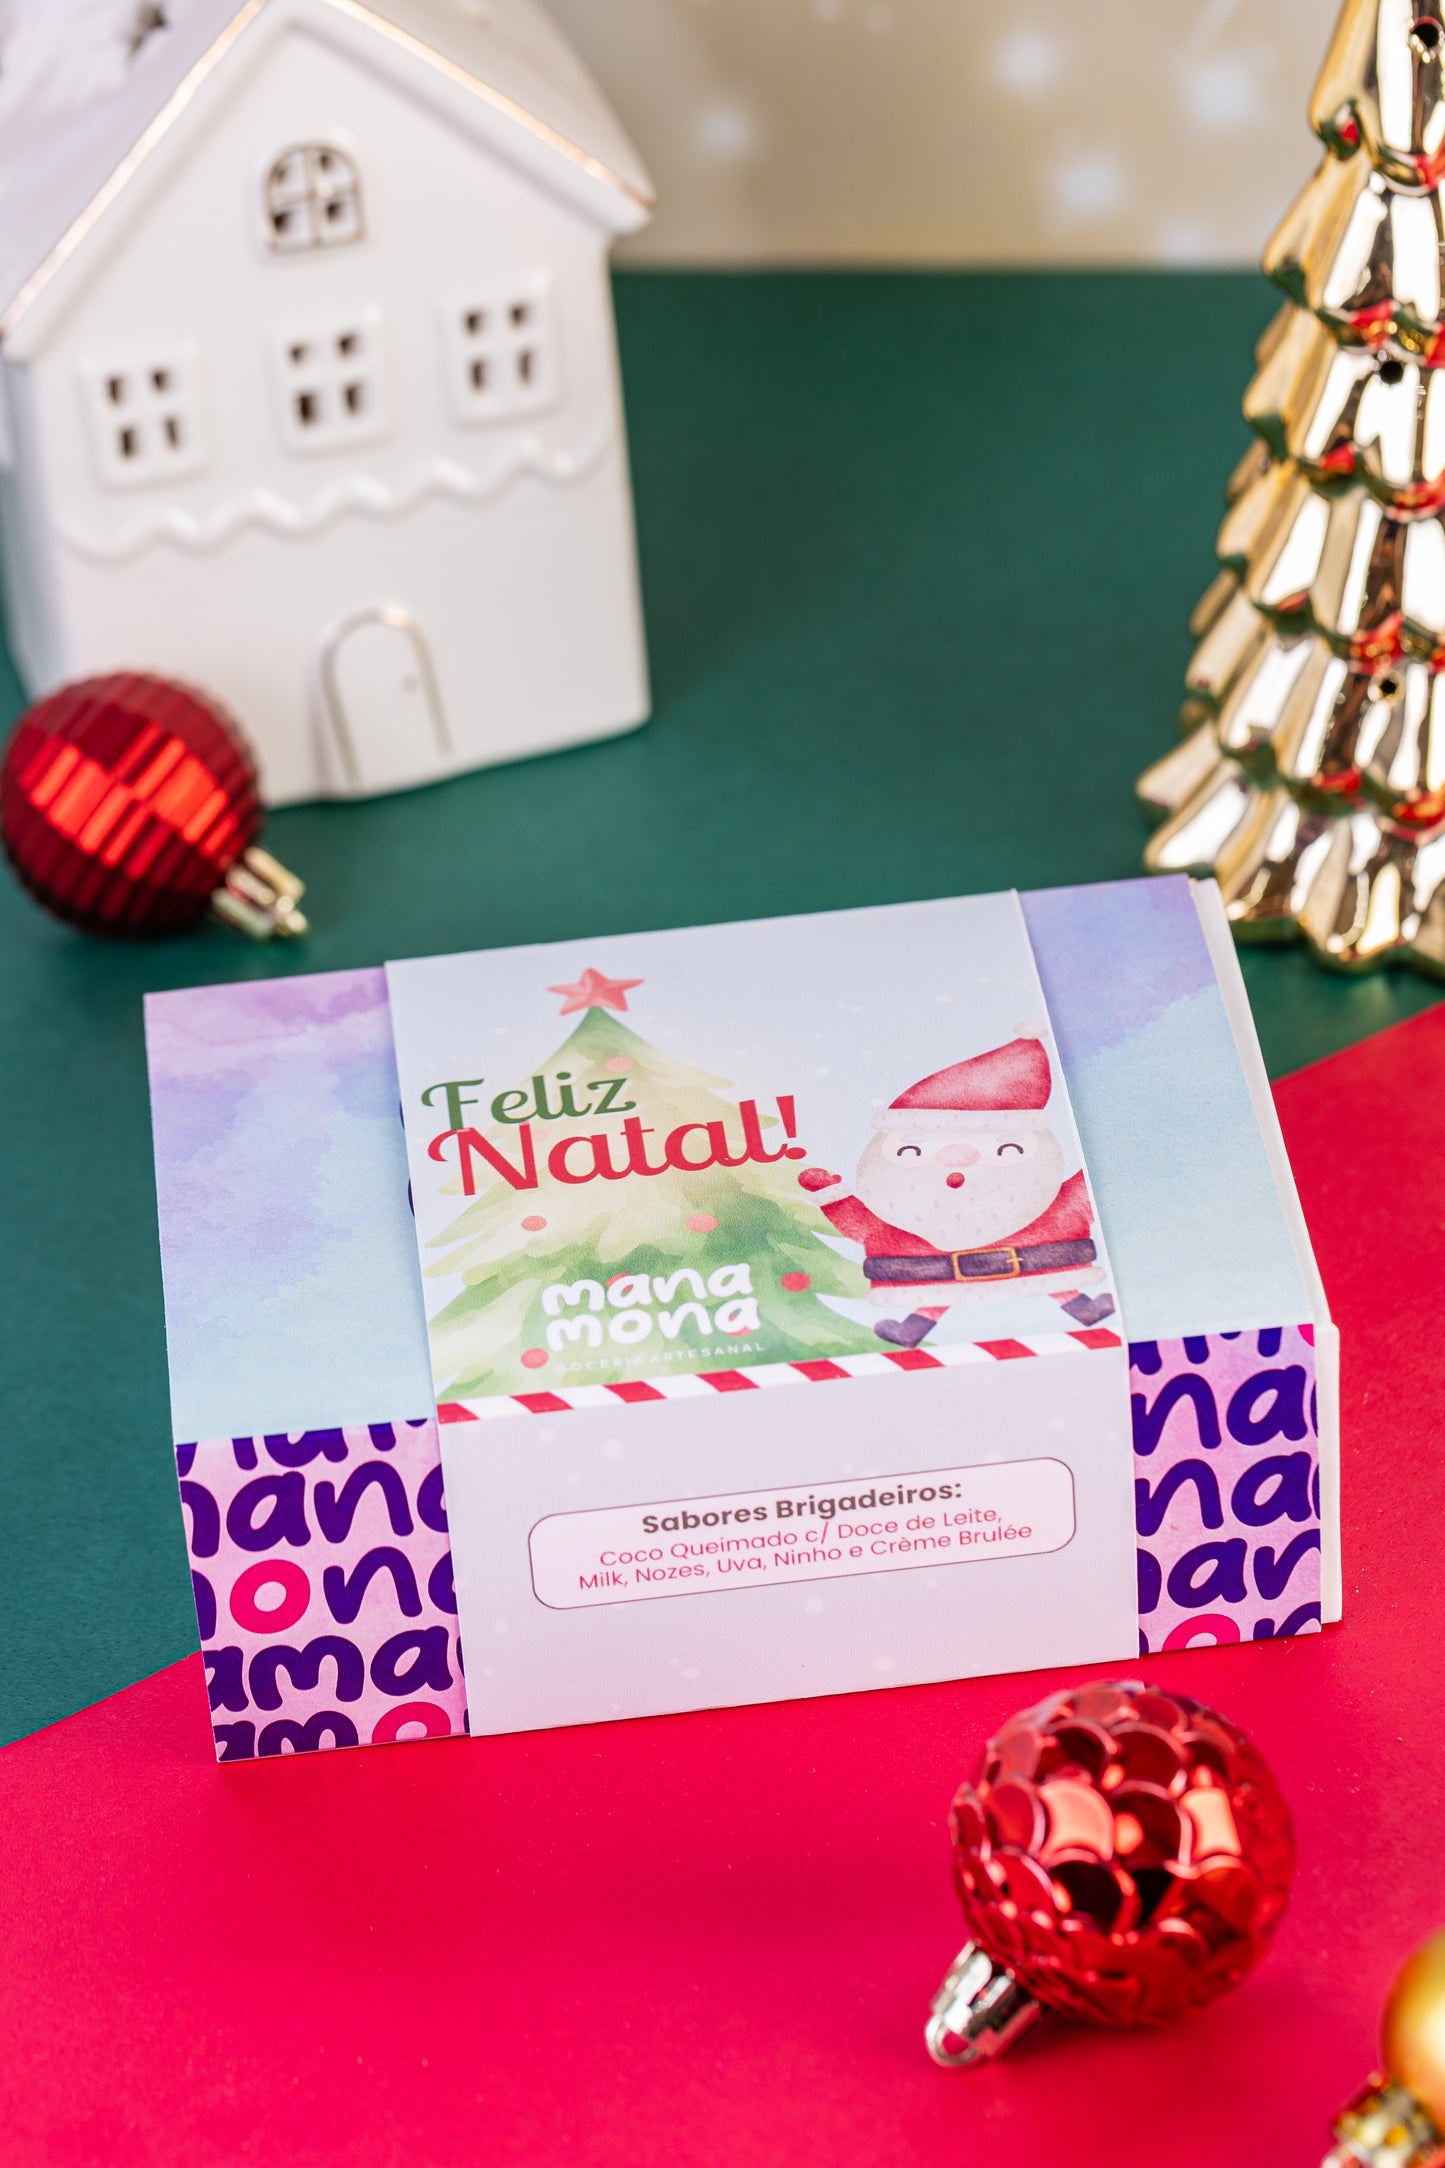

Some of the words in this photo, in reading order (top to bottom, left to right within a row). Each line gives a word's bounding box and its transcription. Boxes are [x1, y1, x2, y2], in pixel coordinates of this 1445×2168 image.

[421, 1072, 637, 1132] Feliz
[427, 1095, 807, 1196] Natal!
[541, 1262, 754, 1317] mana
[546, 1296, 761, 1352] mona
[645, 1341, 765, 1365] ARTESANAL
[600, 1547, 664, 1566] Coco
[670, 1530, 798, 1559] Queimado
[805, 1521, 829, 1544] c/
[837, 1519, 898, 1539] Doce
[906, 1514, 935, 1531] de
[943, 1507, 1003, 1527] Leite,
[642, 1505, 768, 1534] Sabores
[776, 1482, 962, 1519] Brigadeiros:
[579, 1570, 628, 1590] Milk,
[635, 1562, 711, 1583] Nozes,
[717, 1556, 767, 1574] Uva,
[774, 1546, 842, 1566] Ninho
[849, 1544, 863, 1557] e
[870, 1534, 951, 1556] Crème
[958, 1523, 1033, 1546] Brulée
